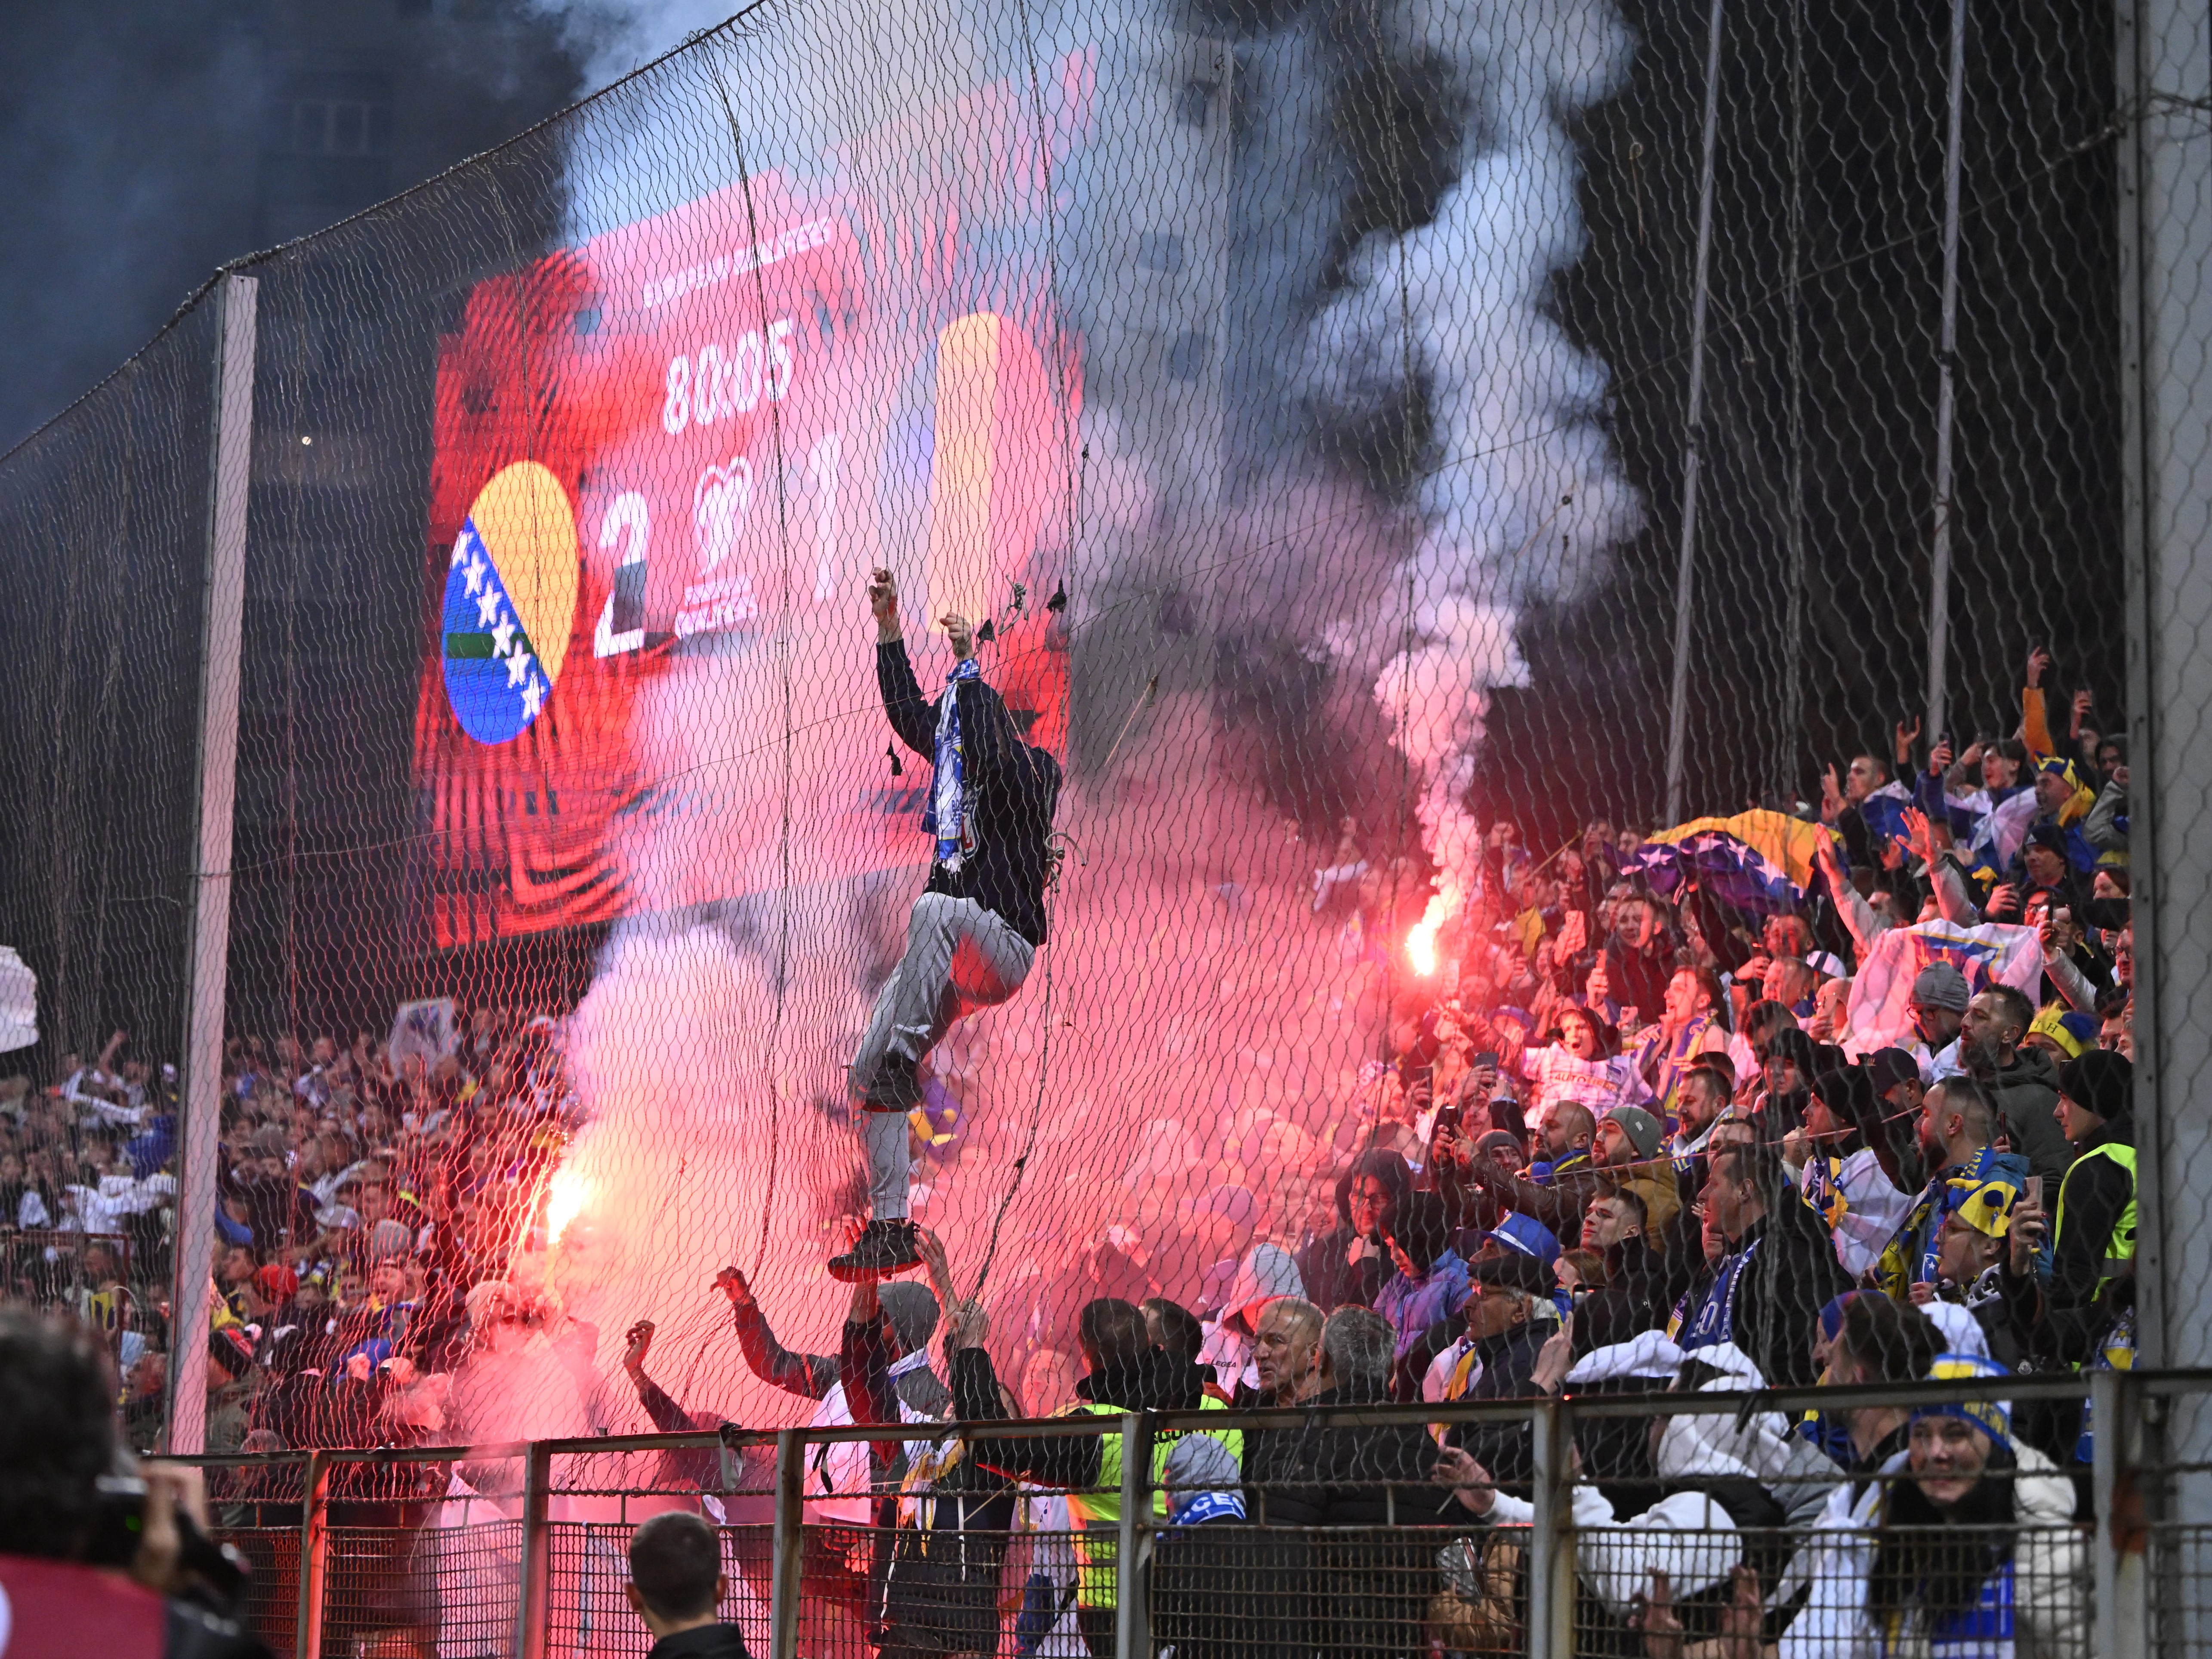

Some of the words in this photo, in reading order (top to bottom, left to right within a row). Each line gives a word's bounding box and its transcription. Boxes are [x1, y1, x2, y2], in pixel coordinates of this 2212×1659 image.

[663, 318, 794, 435] 80:05
[594, 491, 649, 658] 2
[809, 432, 842, 600] 1
